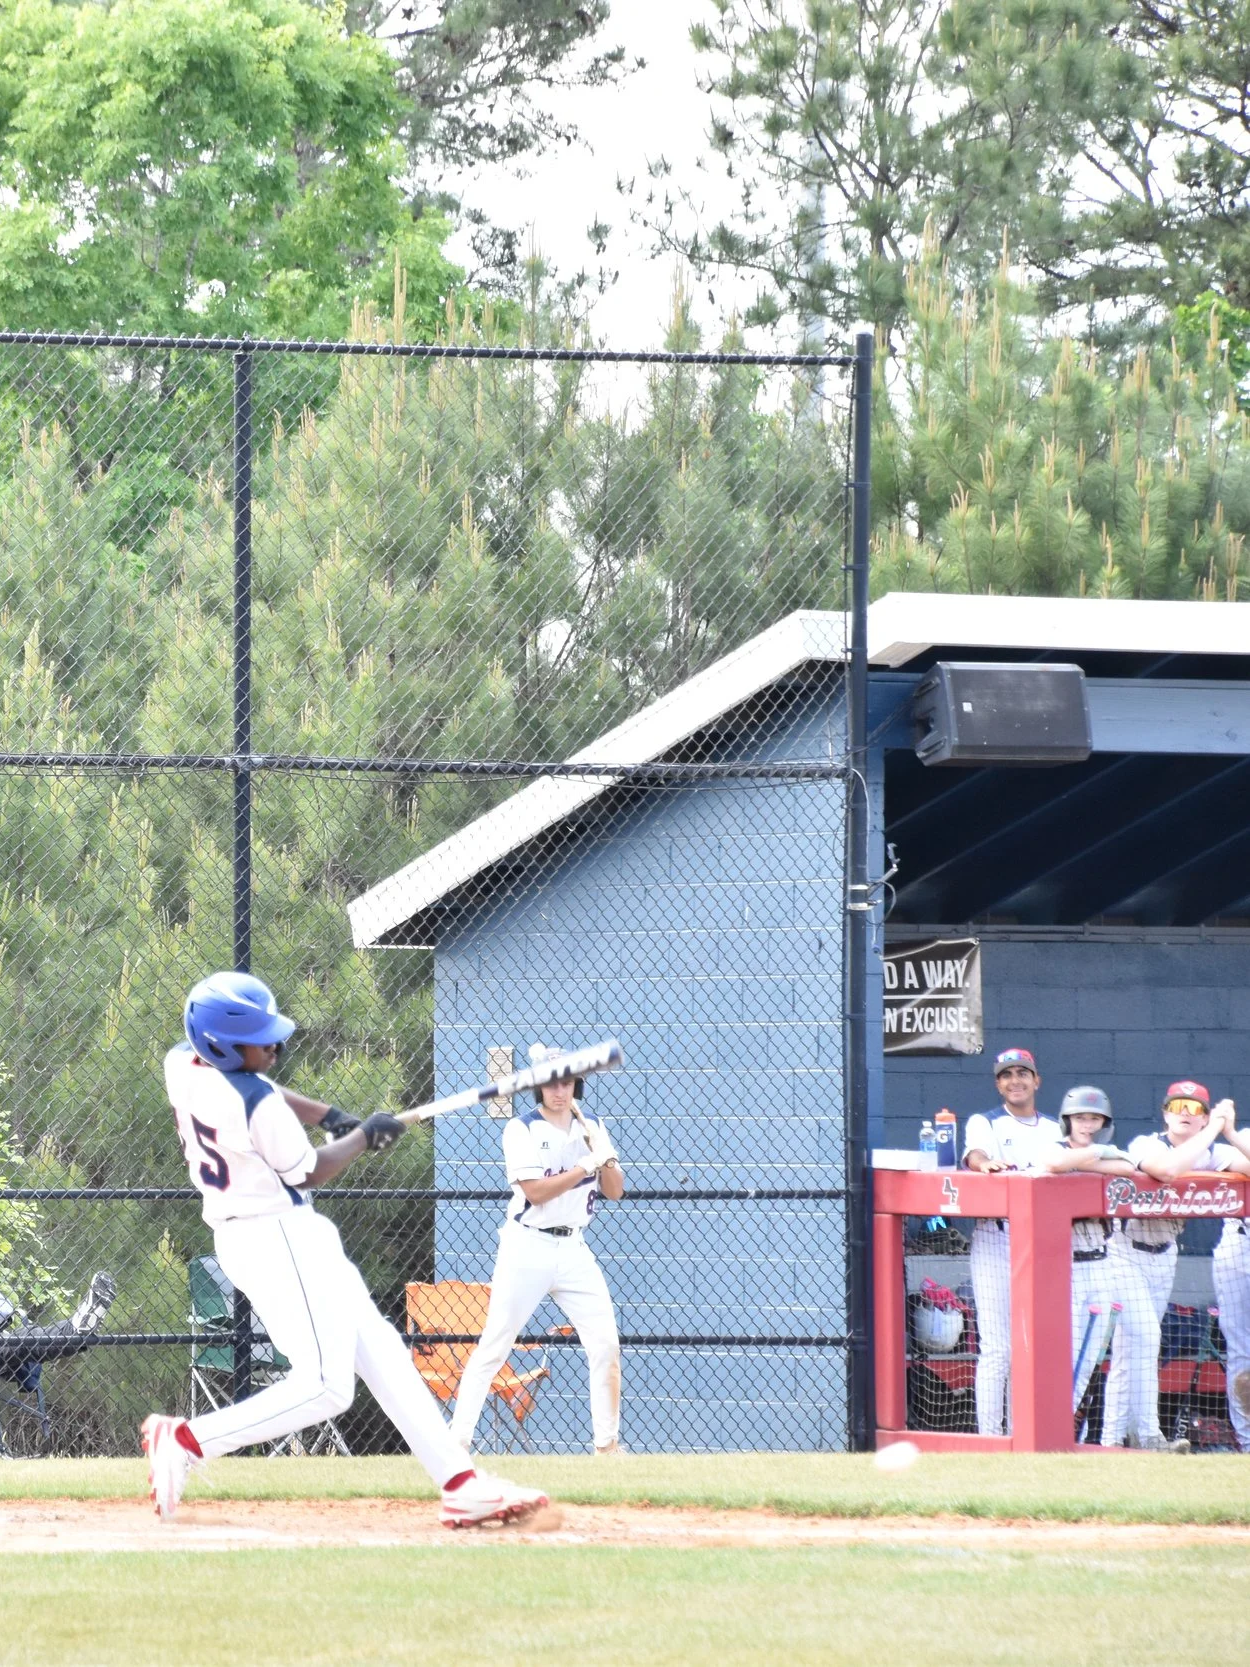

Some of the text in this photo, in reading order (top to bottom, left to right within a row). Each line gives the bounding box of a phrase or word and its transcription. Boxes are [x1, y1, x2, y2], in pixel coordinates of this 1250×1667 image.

[904, 961, 919, 989] A
[921, 960, 970, 988] WAY.
[884, 1006, 976, 1033] N EXCUSE.
[173, 1106, 230, 1192] 5
[1106, 1177, 1244, 1215] Patriots
